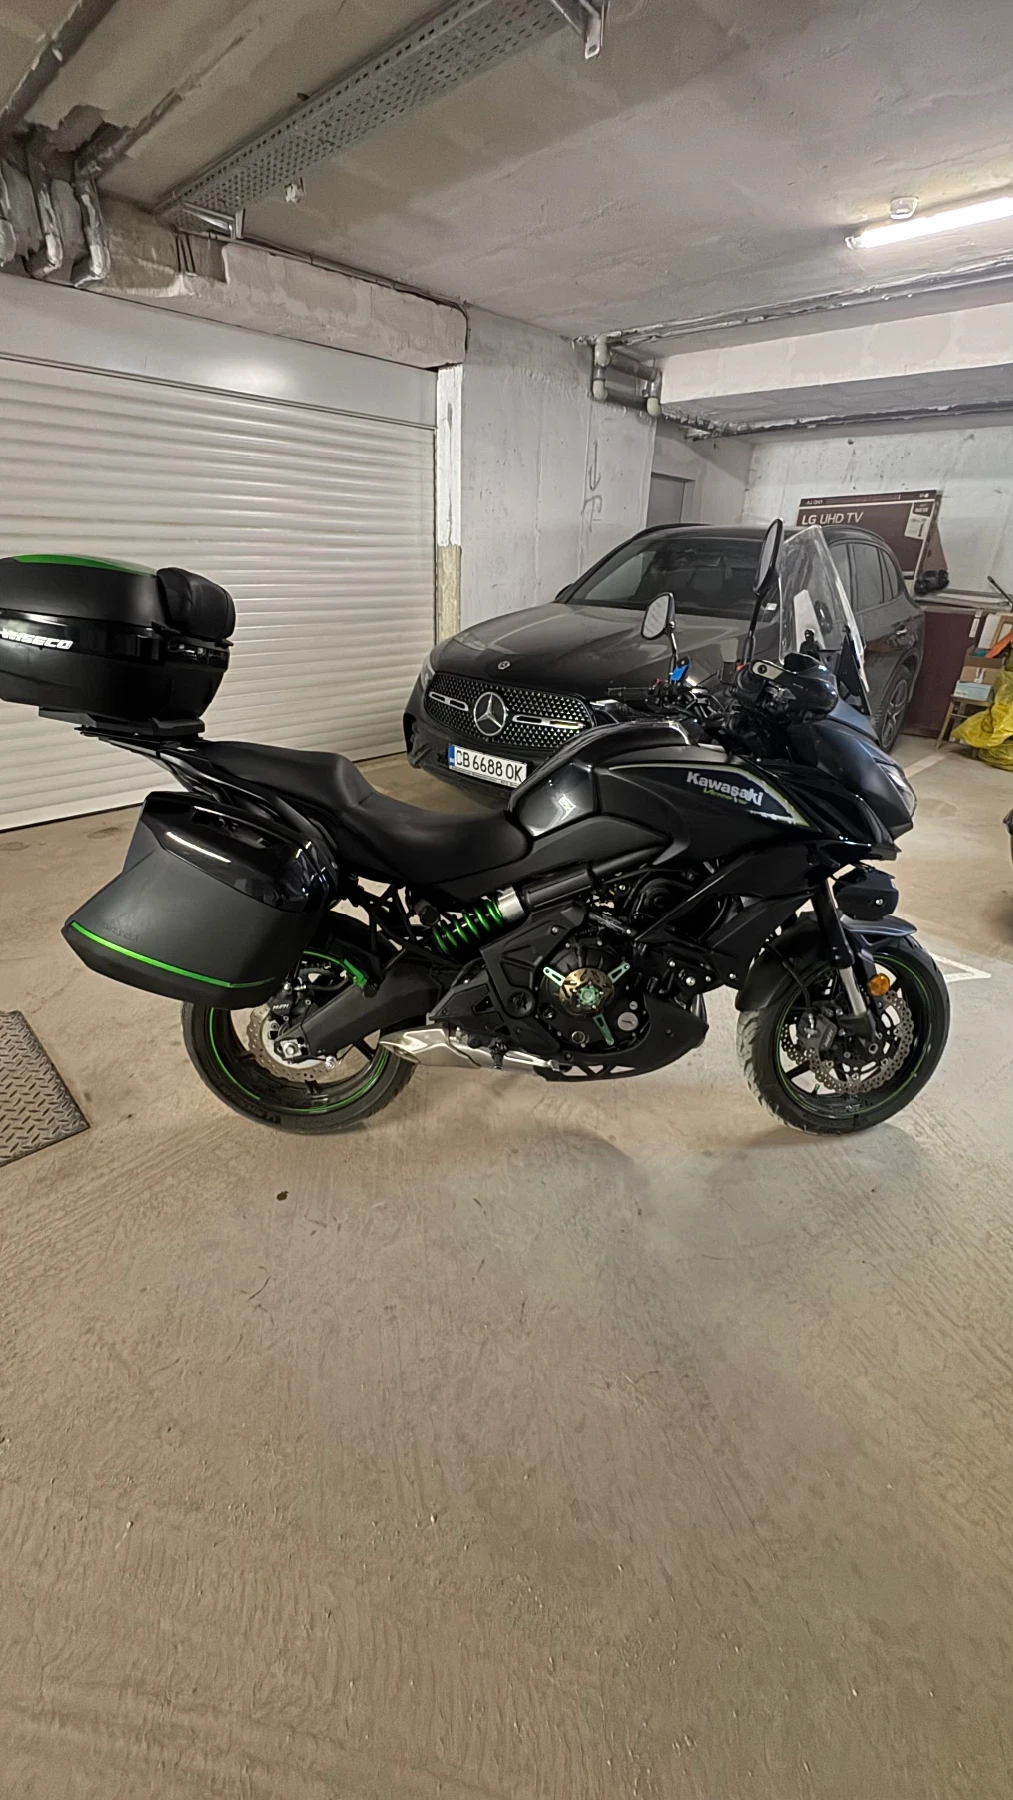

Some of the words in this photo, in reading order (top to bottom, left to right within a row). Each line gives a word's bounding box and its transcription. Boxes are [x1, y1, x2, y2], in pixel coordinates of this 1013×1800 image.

[801, 515, 817, 525] LG
[819, 513, 845, 525] UHD
[846, 512, 864, 523] TV
[456, 750, 470, 768] CB
[472, 755, 503, 777] 6688
[505, 763, 523, 783] OK
[686, 771, 764, 806] Kawasaki
